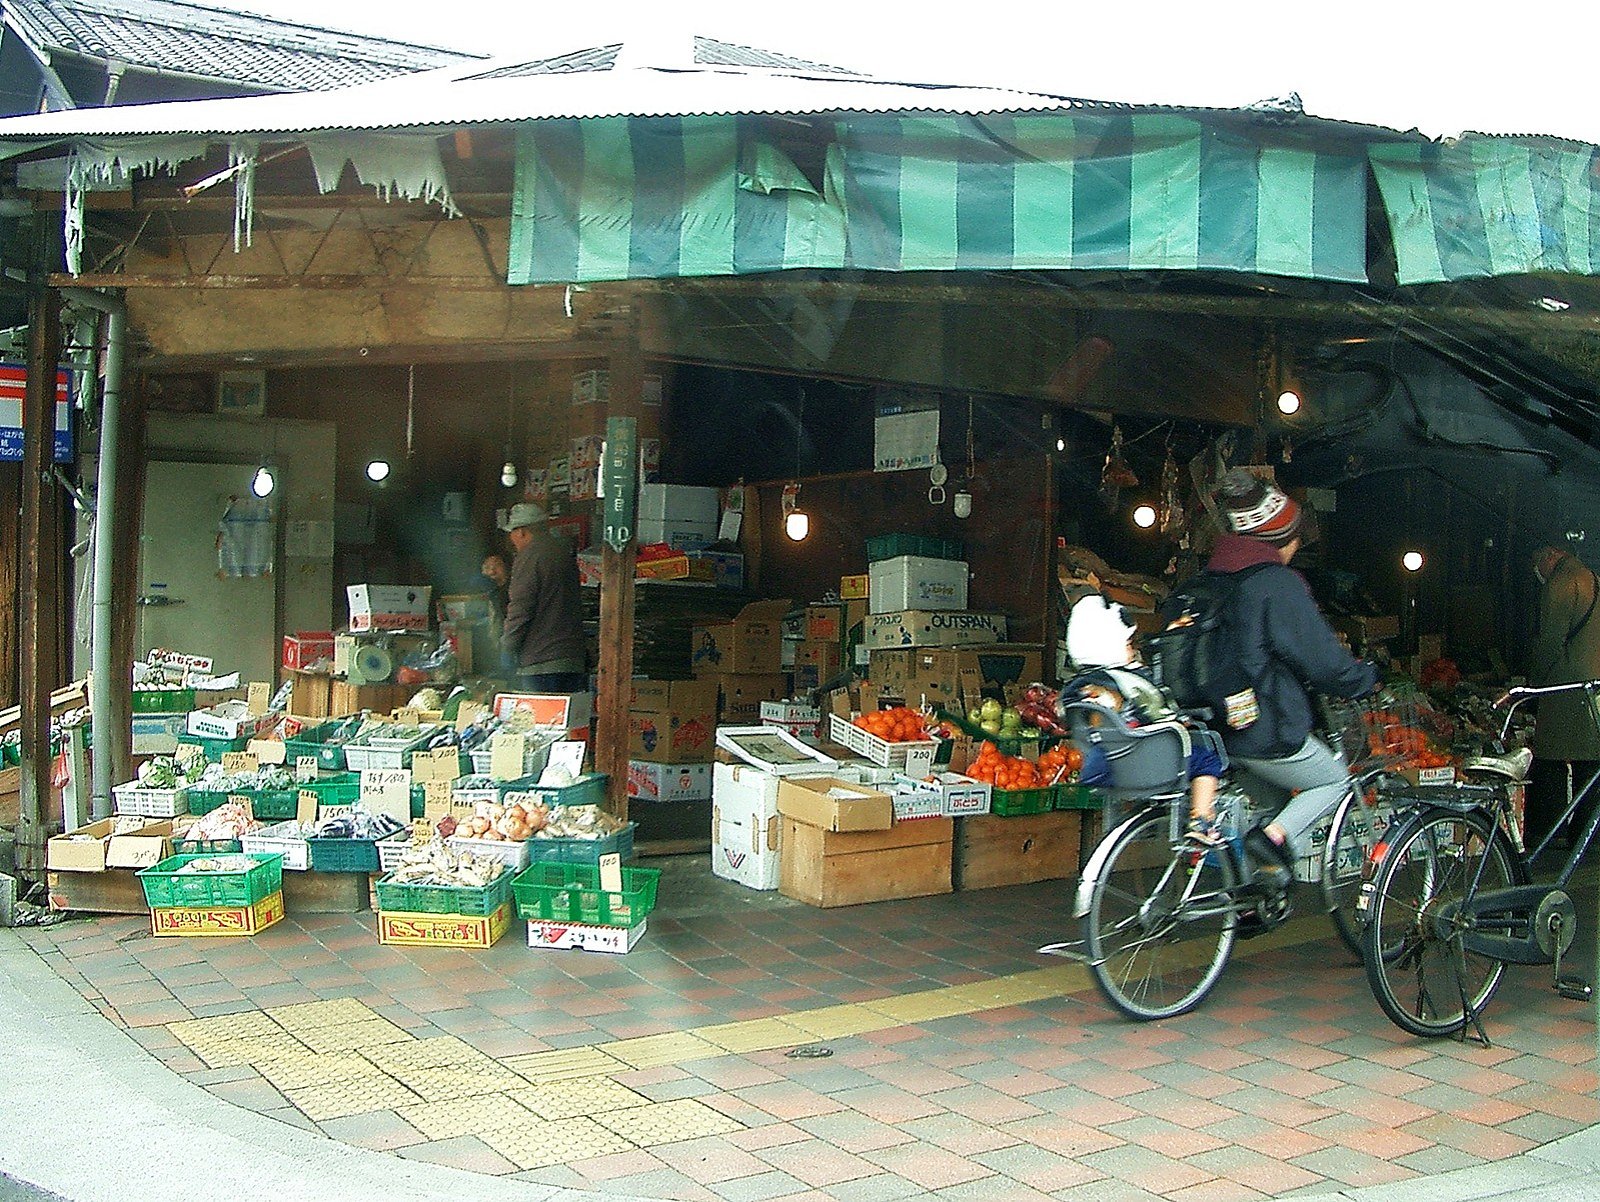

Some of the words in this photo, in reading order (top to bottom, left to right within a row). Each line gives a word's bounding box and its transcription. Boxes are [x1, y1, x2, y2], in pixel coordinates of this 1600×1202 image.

[606, 525, 629, 542] 10
[931, 614, 992, 629] OUTSPAN
[912, 750, 930, 760] 200
